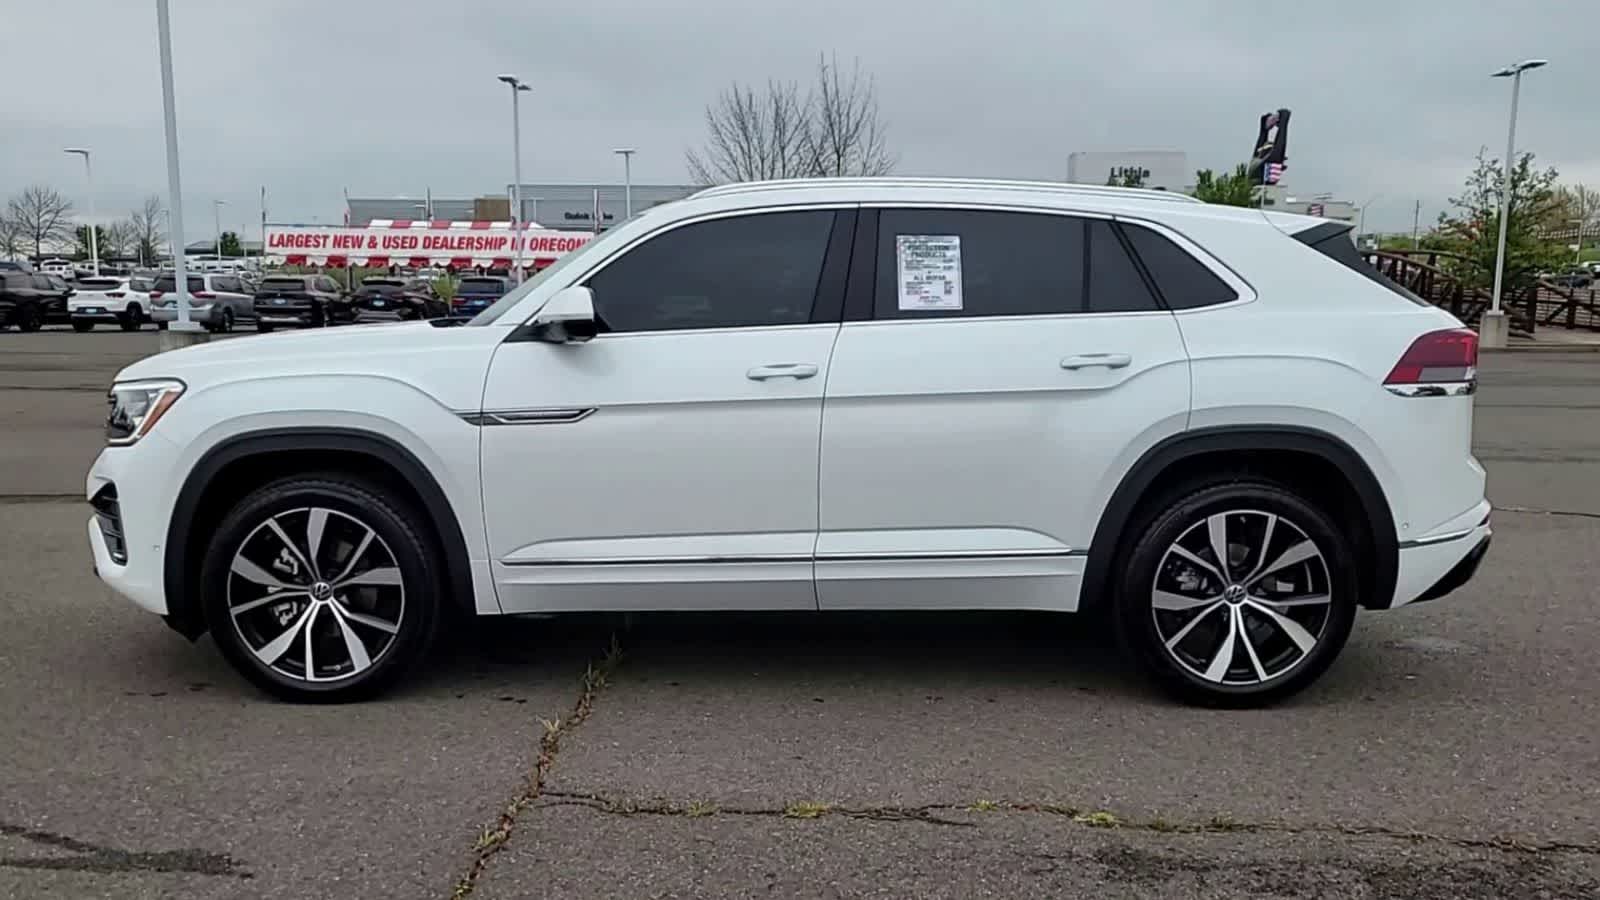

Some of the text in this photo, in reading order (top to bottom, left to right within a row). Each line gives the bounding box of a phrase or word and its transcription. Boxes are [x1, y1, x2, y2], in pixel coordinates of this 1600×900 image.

[268, 233, 329, 248] LARGEST
[332, 234, 364, 249] NEW
[367, 235, 378, 249] &
[382, 236, 418, 250] USED
[422, 236, 508, 250] DEALERSHIP
